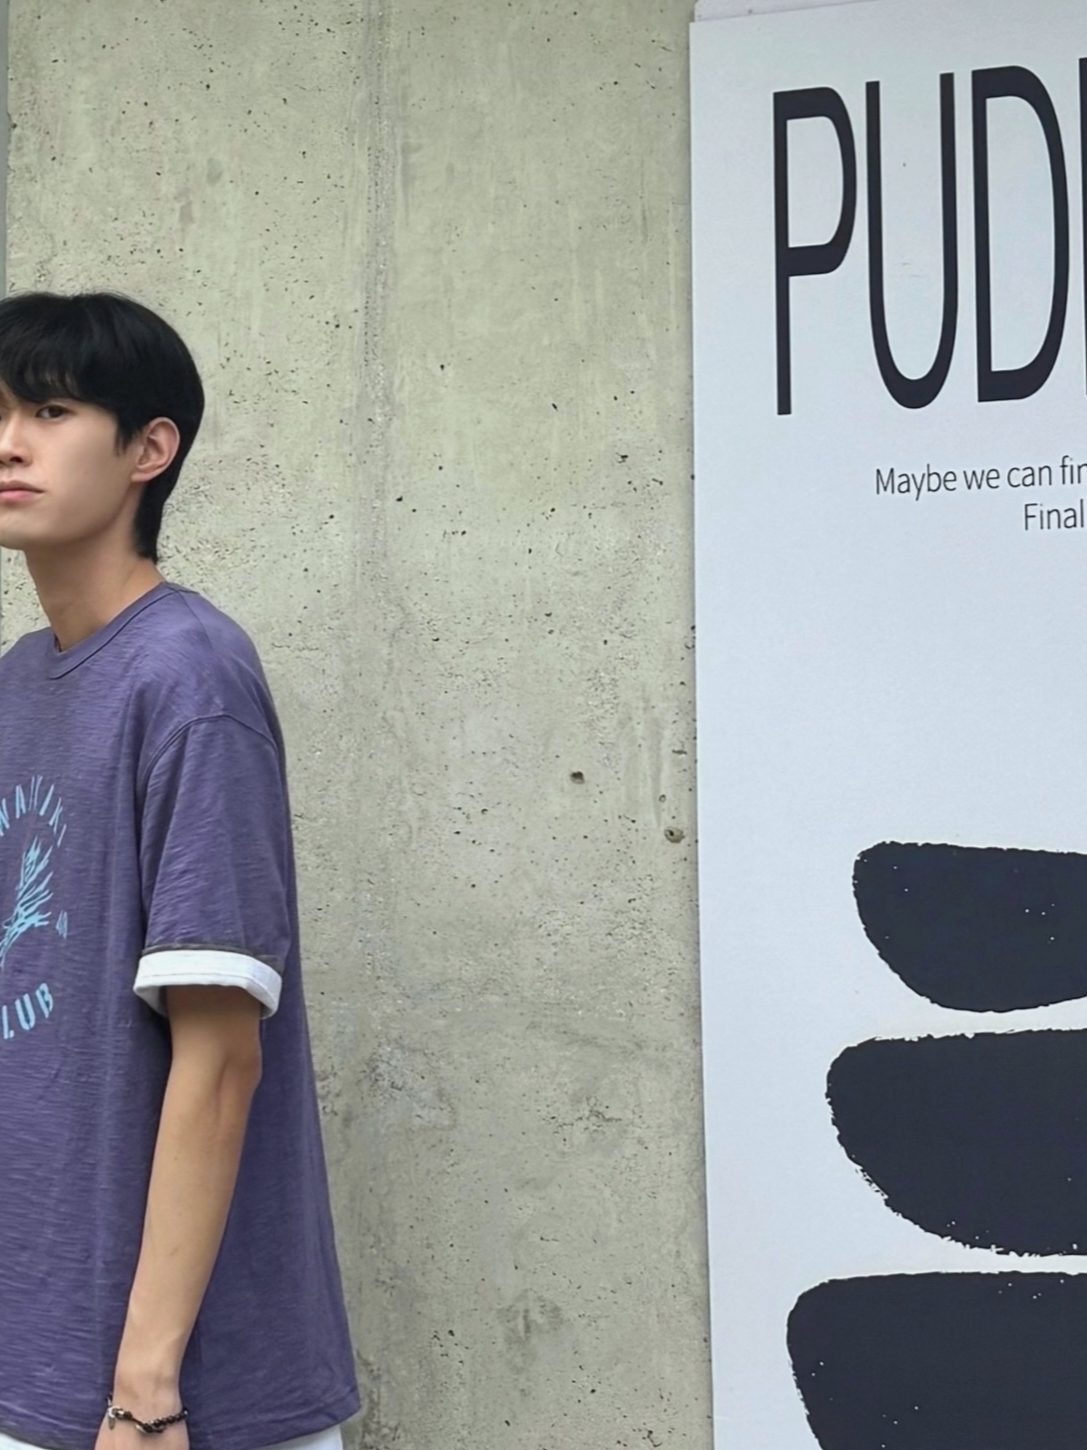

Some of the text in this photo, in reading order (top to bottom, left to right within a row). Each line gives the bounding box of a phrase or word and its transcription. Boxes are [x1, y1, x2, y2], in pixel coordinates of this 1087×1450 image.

[773, 57, 1087, 415] PUD
[876, 463, 957, 501] Maybe
[963, 468, 1000, 490] we
[1007, 465, 1052, 488] can
[1024, 499, 1084, 530] Final
